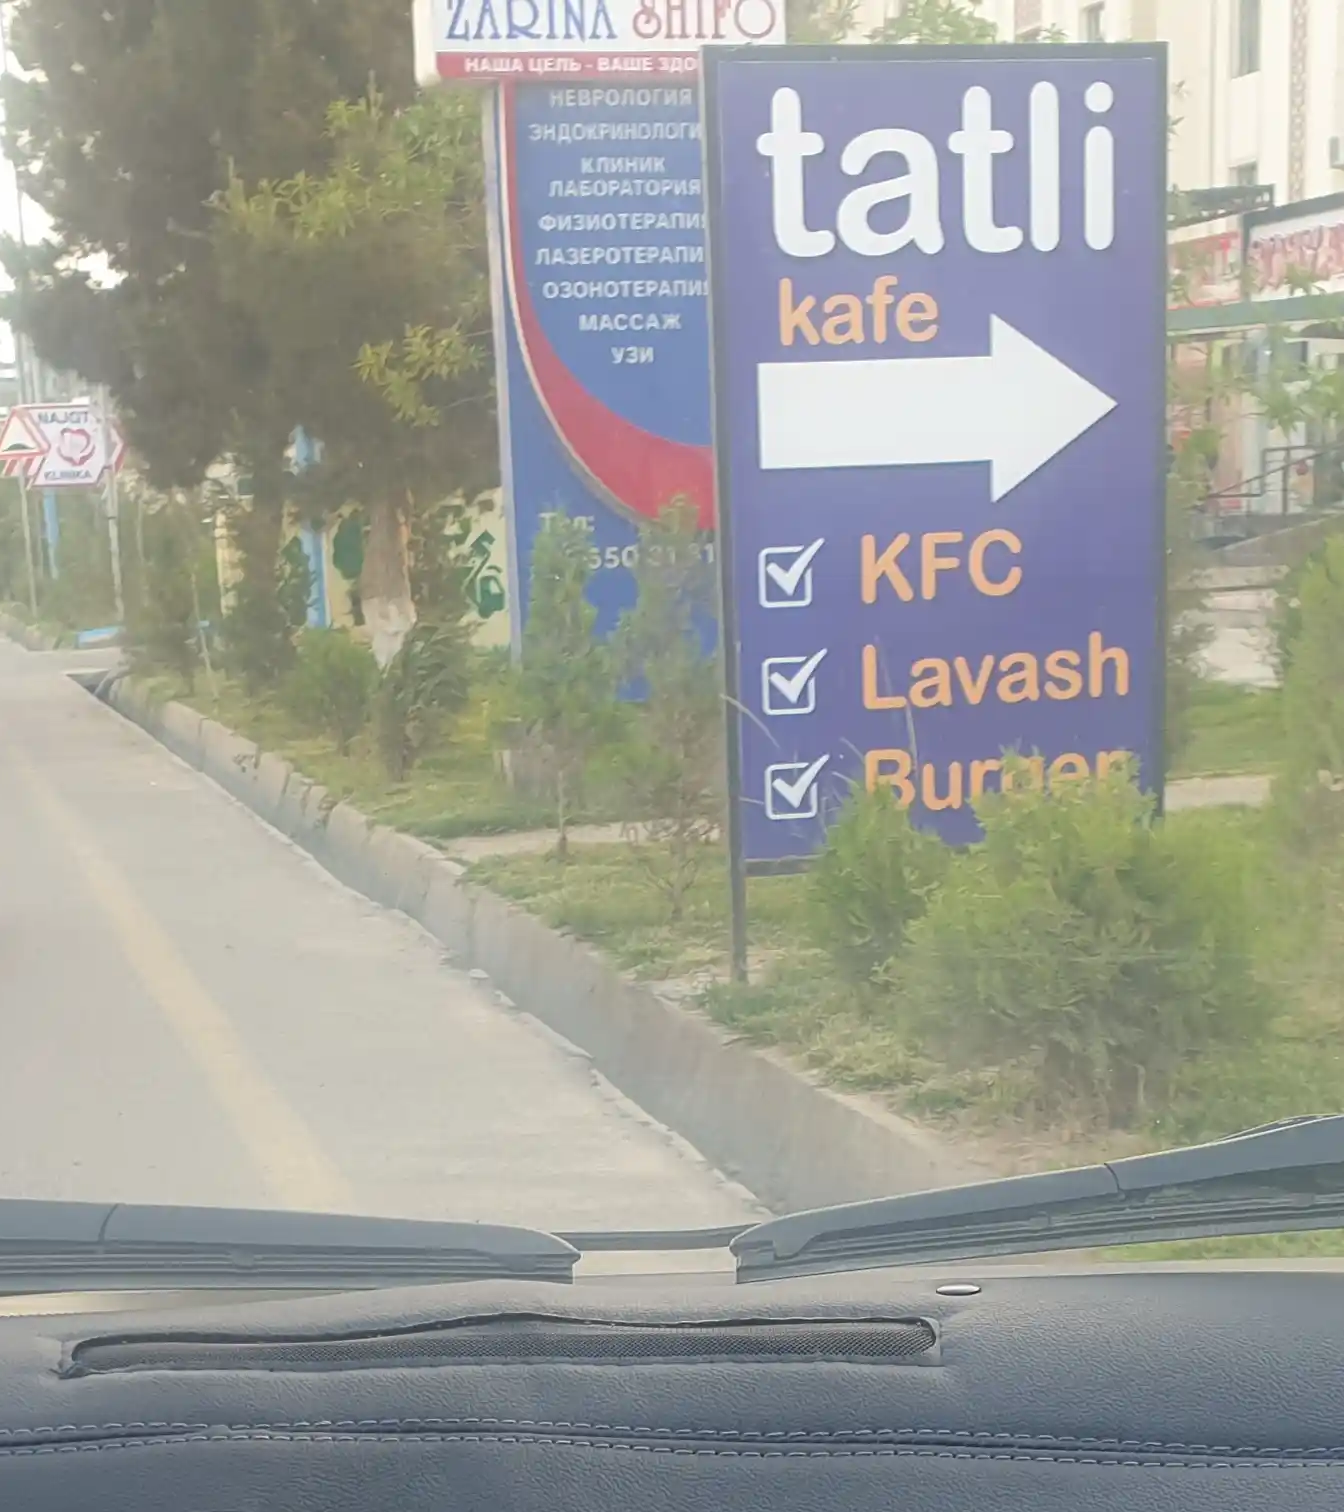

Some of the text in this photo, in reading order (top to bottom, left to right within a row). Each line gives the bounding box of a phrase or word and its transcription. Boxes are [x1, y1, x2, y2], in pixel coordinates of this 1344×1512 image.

[445, 0, 777, 42] ZARINA SHIFO
[464, 57, 524, 73] НАША
[528, 57, 582, 75] ЦЕЛЬ
[597, 57, 654, 72] ВАШЕ
[549, 88, 693, 108] НЕВРОЛОГИЯ
[580, 156, 666, 174] КЛИНИК
[756, 81, 1115, 258] tatli
[548, 178, 702, 198] ЛАБОРАТОРИЯ
[779, 275, 939, 346] kafe
[578, 313, 682, 332] МАССАЖ
[611, 346, 654, 364] УЗИ
[861, 529, 1022, 604] KFC
[862, 631, 1130, 710] Lavash
